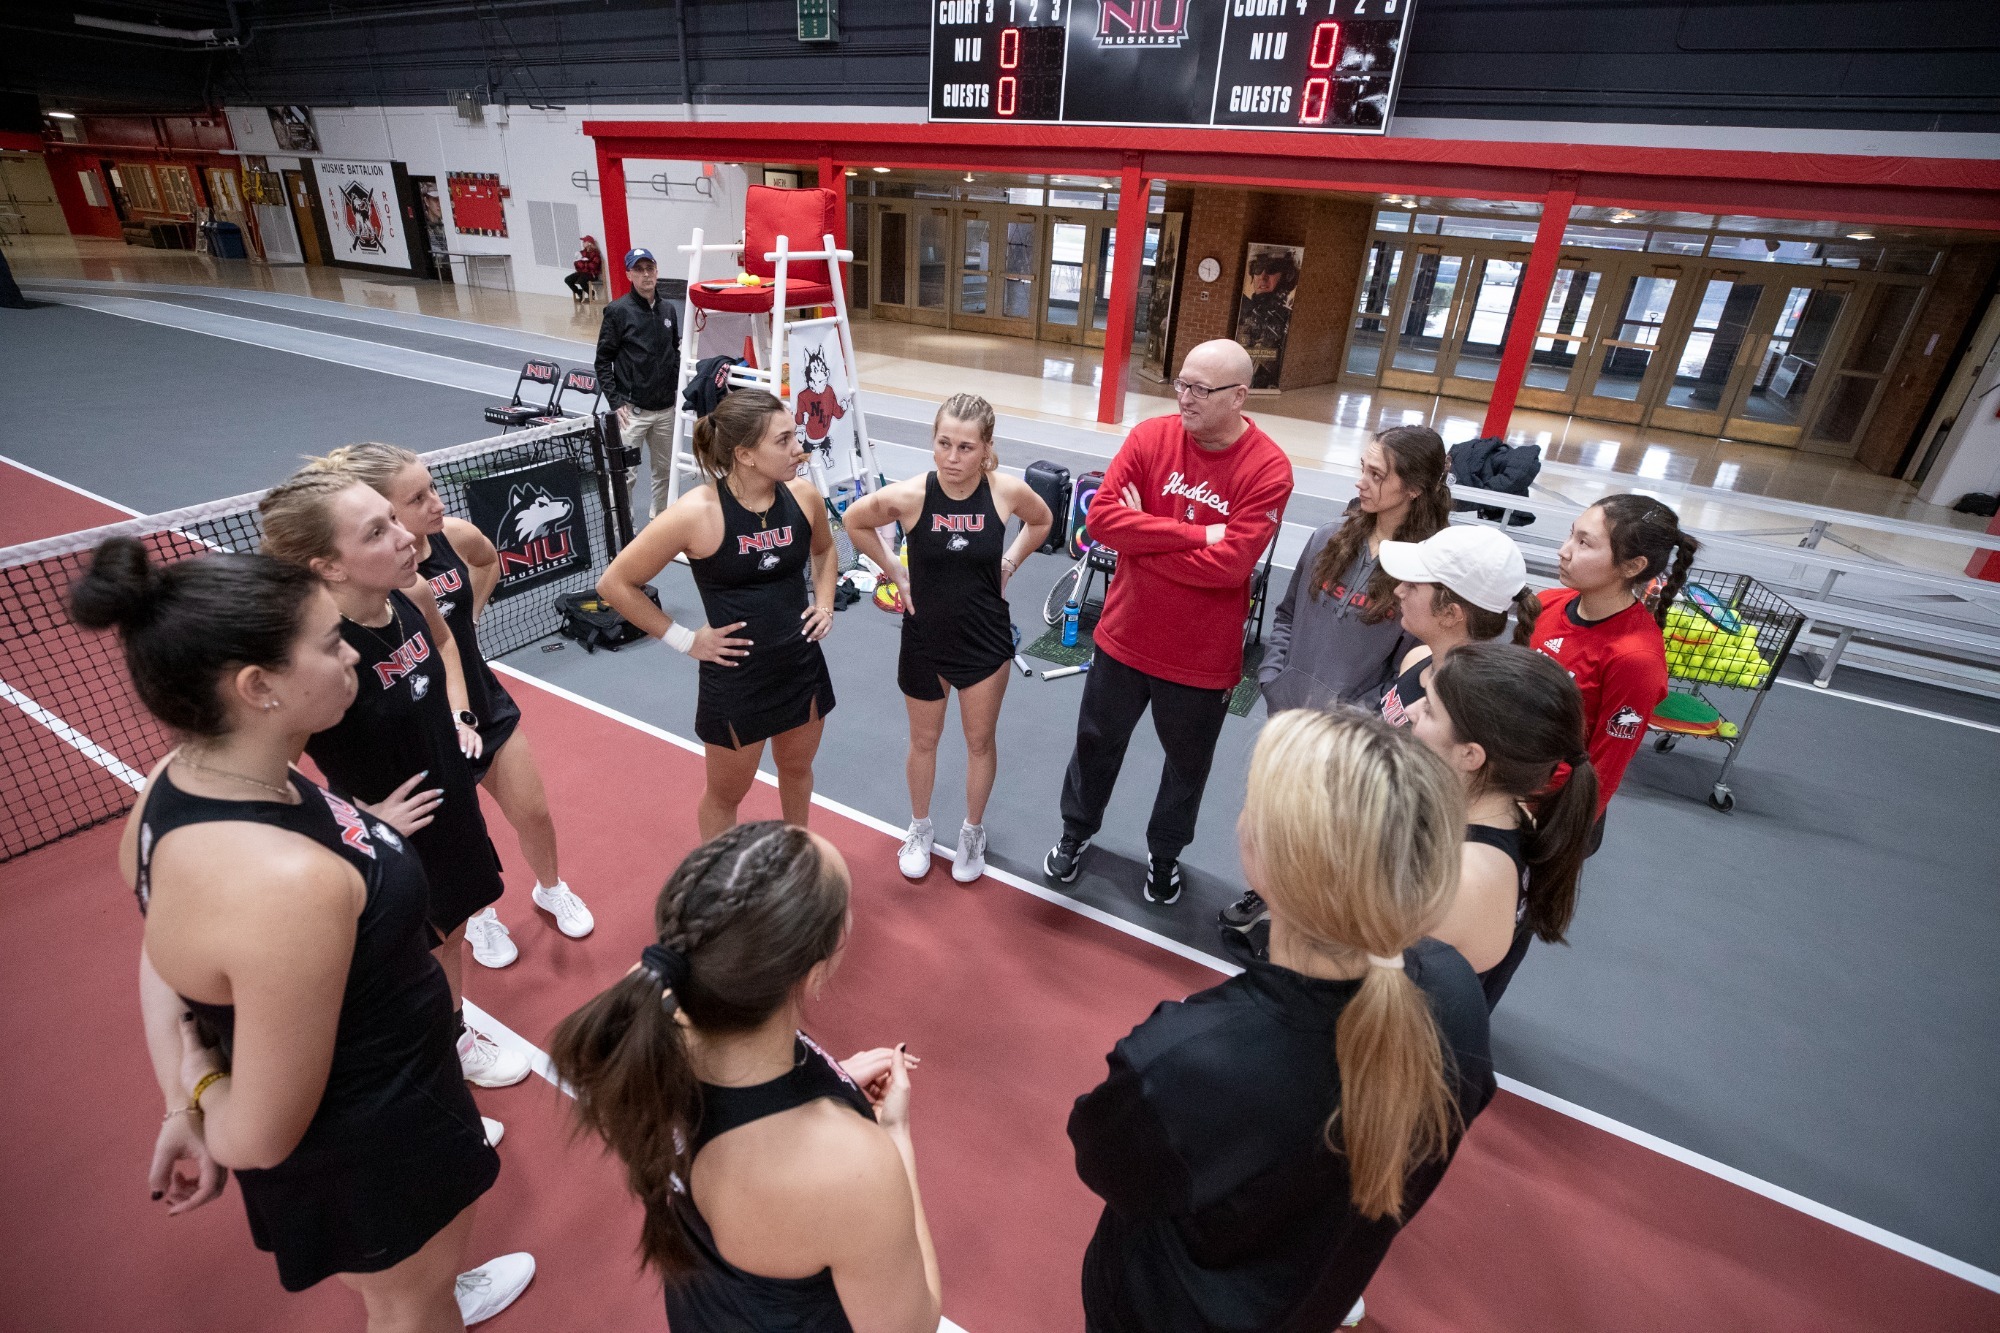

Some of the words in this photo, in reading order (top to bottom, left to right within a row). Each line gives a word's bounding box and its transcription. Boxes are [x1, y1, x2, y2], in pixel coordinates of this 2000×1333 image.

[939, 0, 980, 24] COURT
[985, 0, 995, 23] 3
[1009, 0, 1016, 22] 1
[1028, 0, 1039, 22] 2
[1051, 0, 1061, 21] 3
[1101, 0, 1185, 34] NIU
[1233, 0, 1289, 17] COURT
[954, 37, 982, 62] NIU
[1000, 28, 1019, 69] 0
[1104, 36, 1175, 44] HUSKIES
[1249, 32, 1288, 60] NIU
[1310, 22, 1340, 69] 0
[943, 83, 990, 108] GUESTS
[997, 76, 1017, 115] 0
[1229, 85, 1293, 113] GUESTS
[1300, 77, 1330, 123] 0
[321, 162, 346, 175] HUSKIE
[346, 163, 384, 176] BATTALION
[328, 187, 340, 232] ARMY
[381, 191, 395, 238] ROTC
[526, 363, 552, 380] NIU
[567, 374, 596, 391] NIU
[1161, 471, 1230, 516] Huskies
[931, 513, 986, 532] NIU
[498, 530, 570, 577] NIU
[736, 525, 794, 555] NIU
[428, 568, 463, 599] IU
[508, 556, 568, 583] HUSKIES
[372, 631, 430, 690] NIU
[317, 786, 377, 860] NIU
